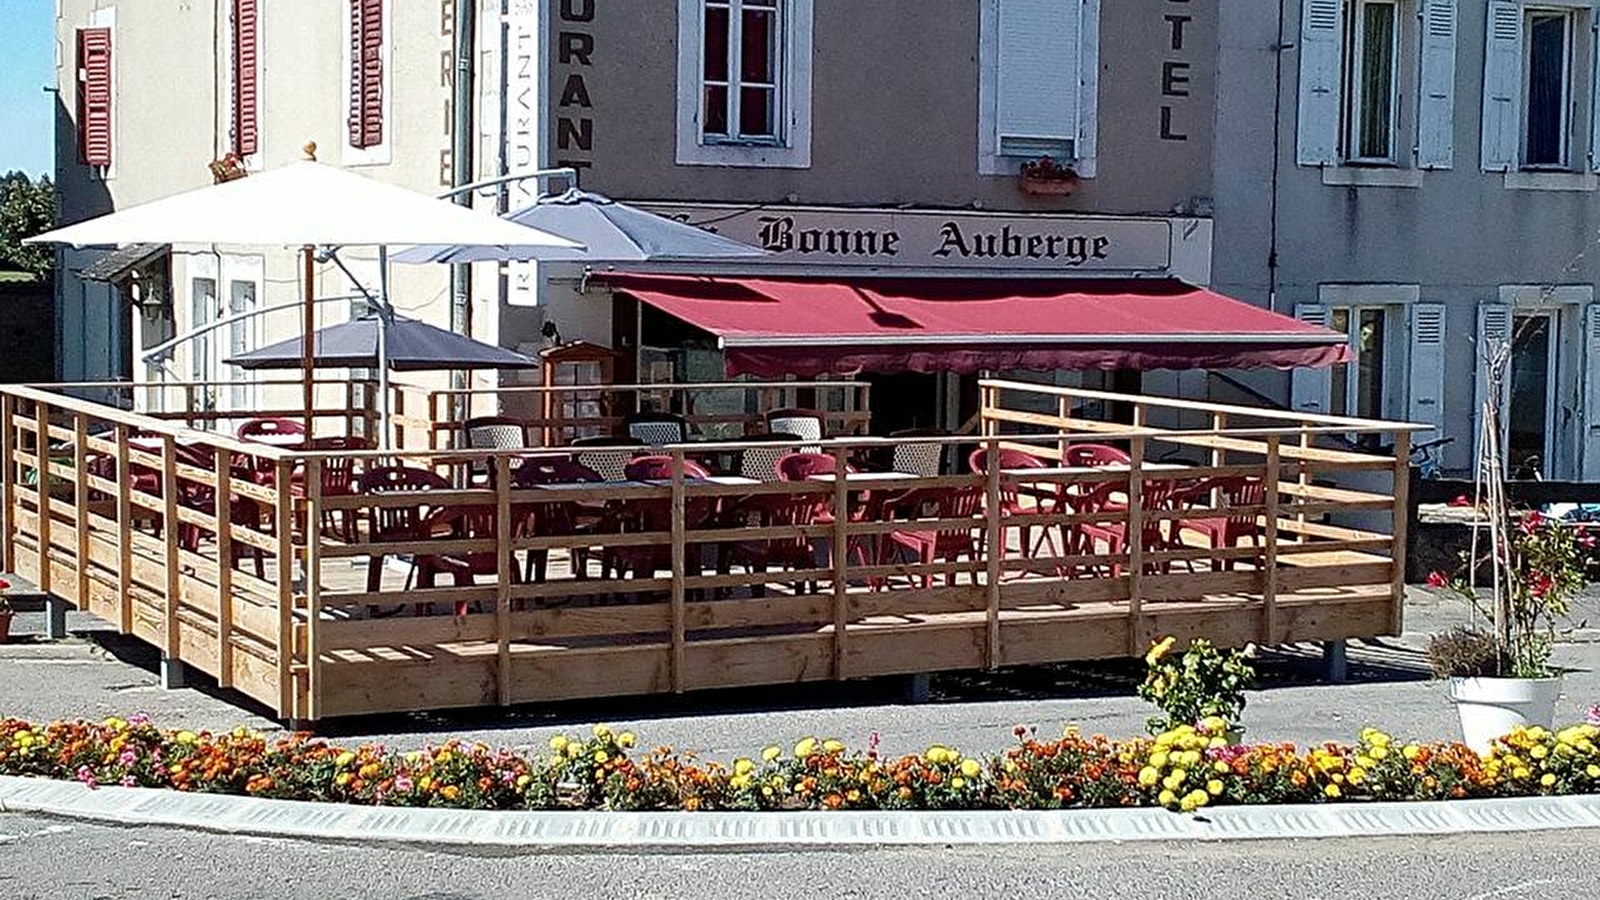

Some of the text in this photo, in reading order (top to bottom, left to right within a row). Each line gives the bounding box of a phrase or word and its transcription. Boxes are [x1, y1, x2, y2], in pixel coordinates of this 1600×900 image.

[557, 0, 595, 169] URAN
[1160, 0, 1192, 141] TEL
[517, 25, 532, 292] RAURANT
[758, 216, 900, 255] Bonne
[932, 221, 1110, 267] Auberge
